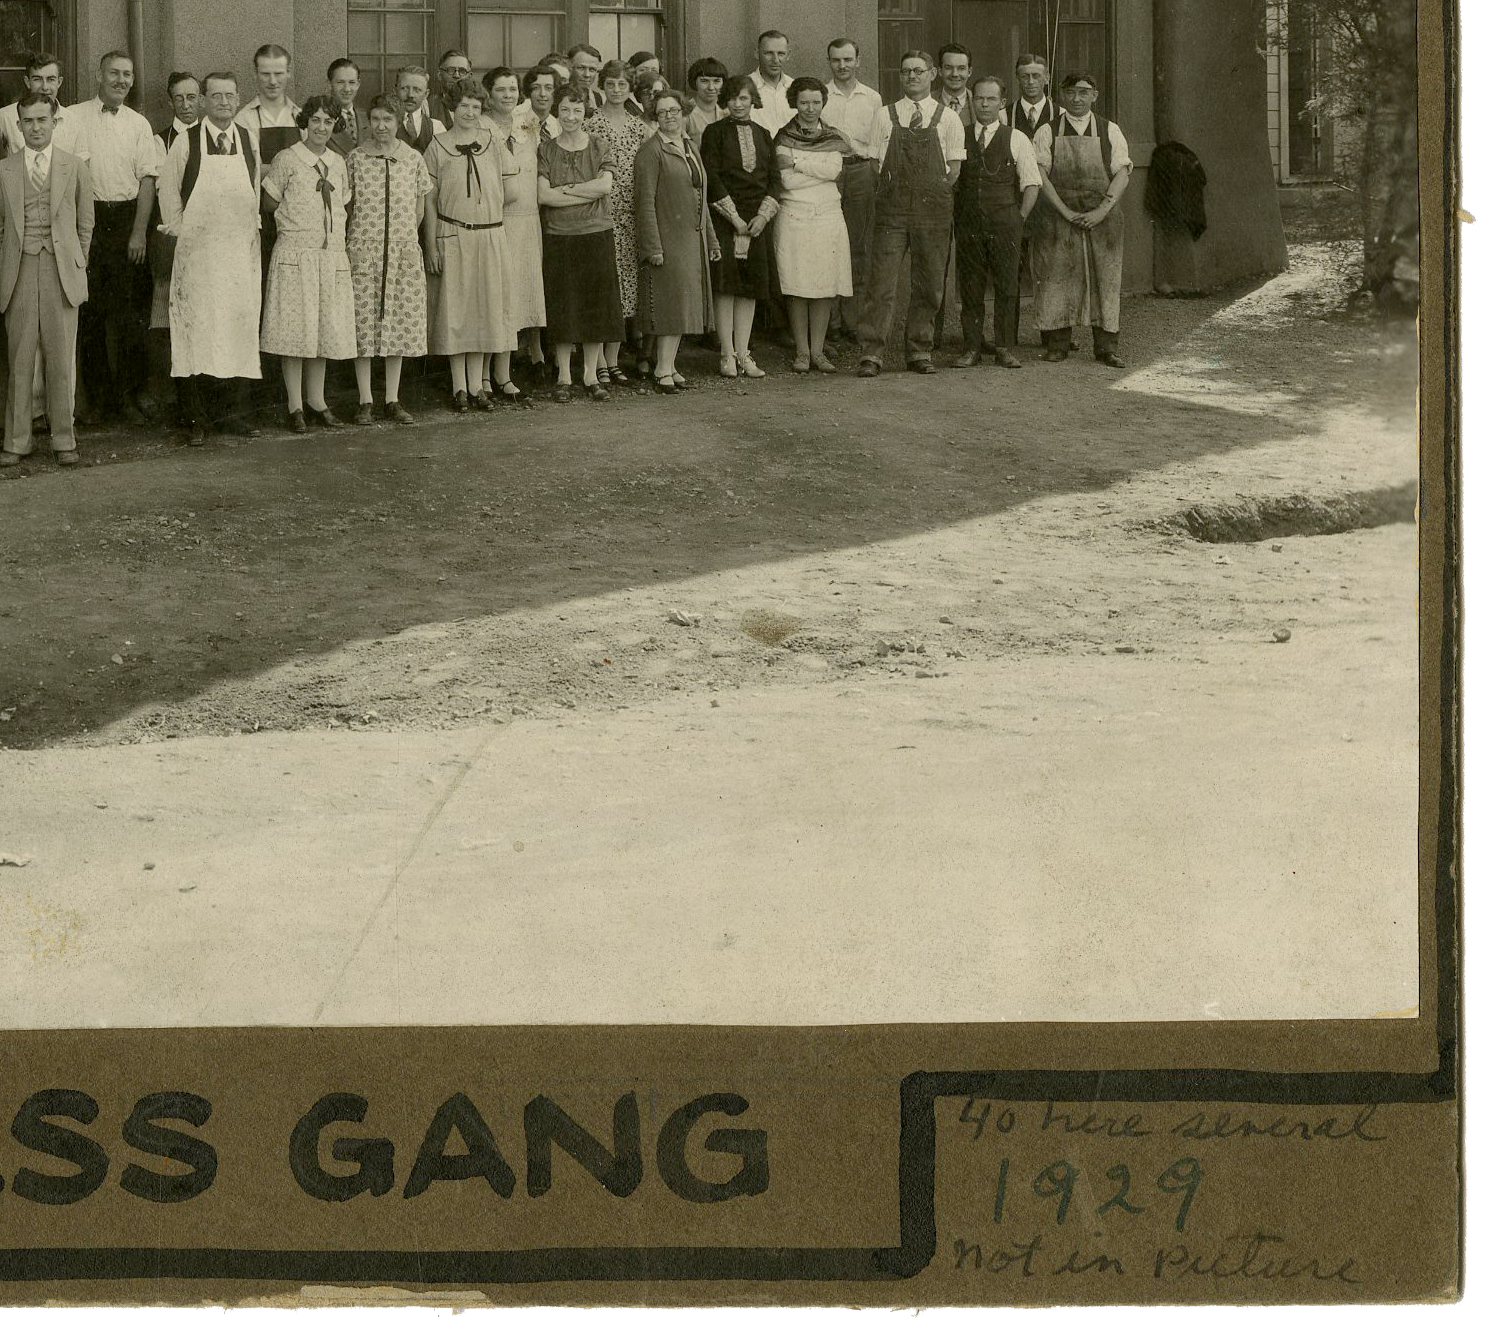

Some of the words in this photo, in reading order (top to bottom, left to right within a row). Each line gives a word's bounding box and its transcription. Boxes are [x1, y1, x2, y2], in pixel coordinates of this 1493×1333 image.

[290, 1092, 769, 1203] GANG
[1173, 1104, 1387, 1142] several
[994, 1156, 1206, 1234] 1929
[1051, 1231, 1125, 1276] in
